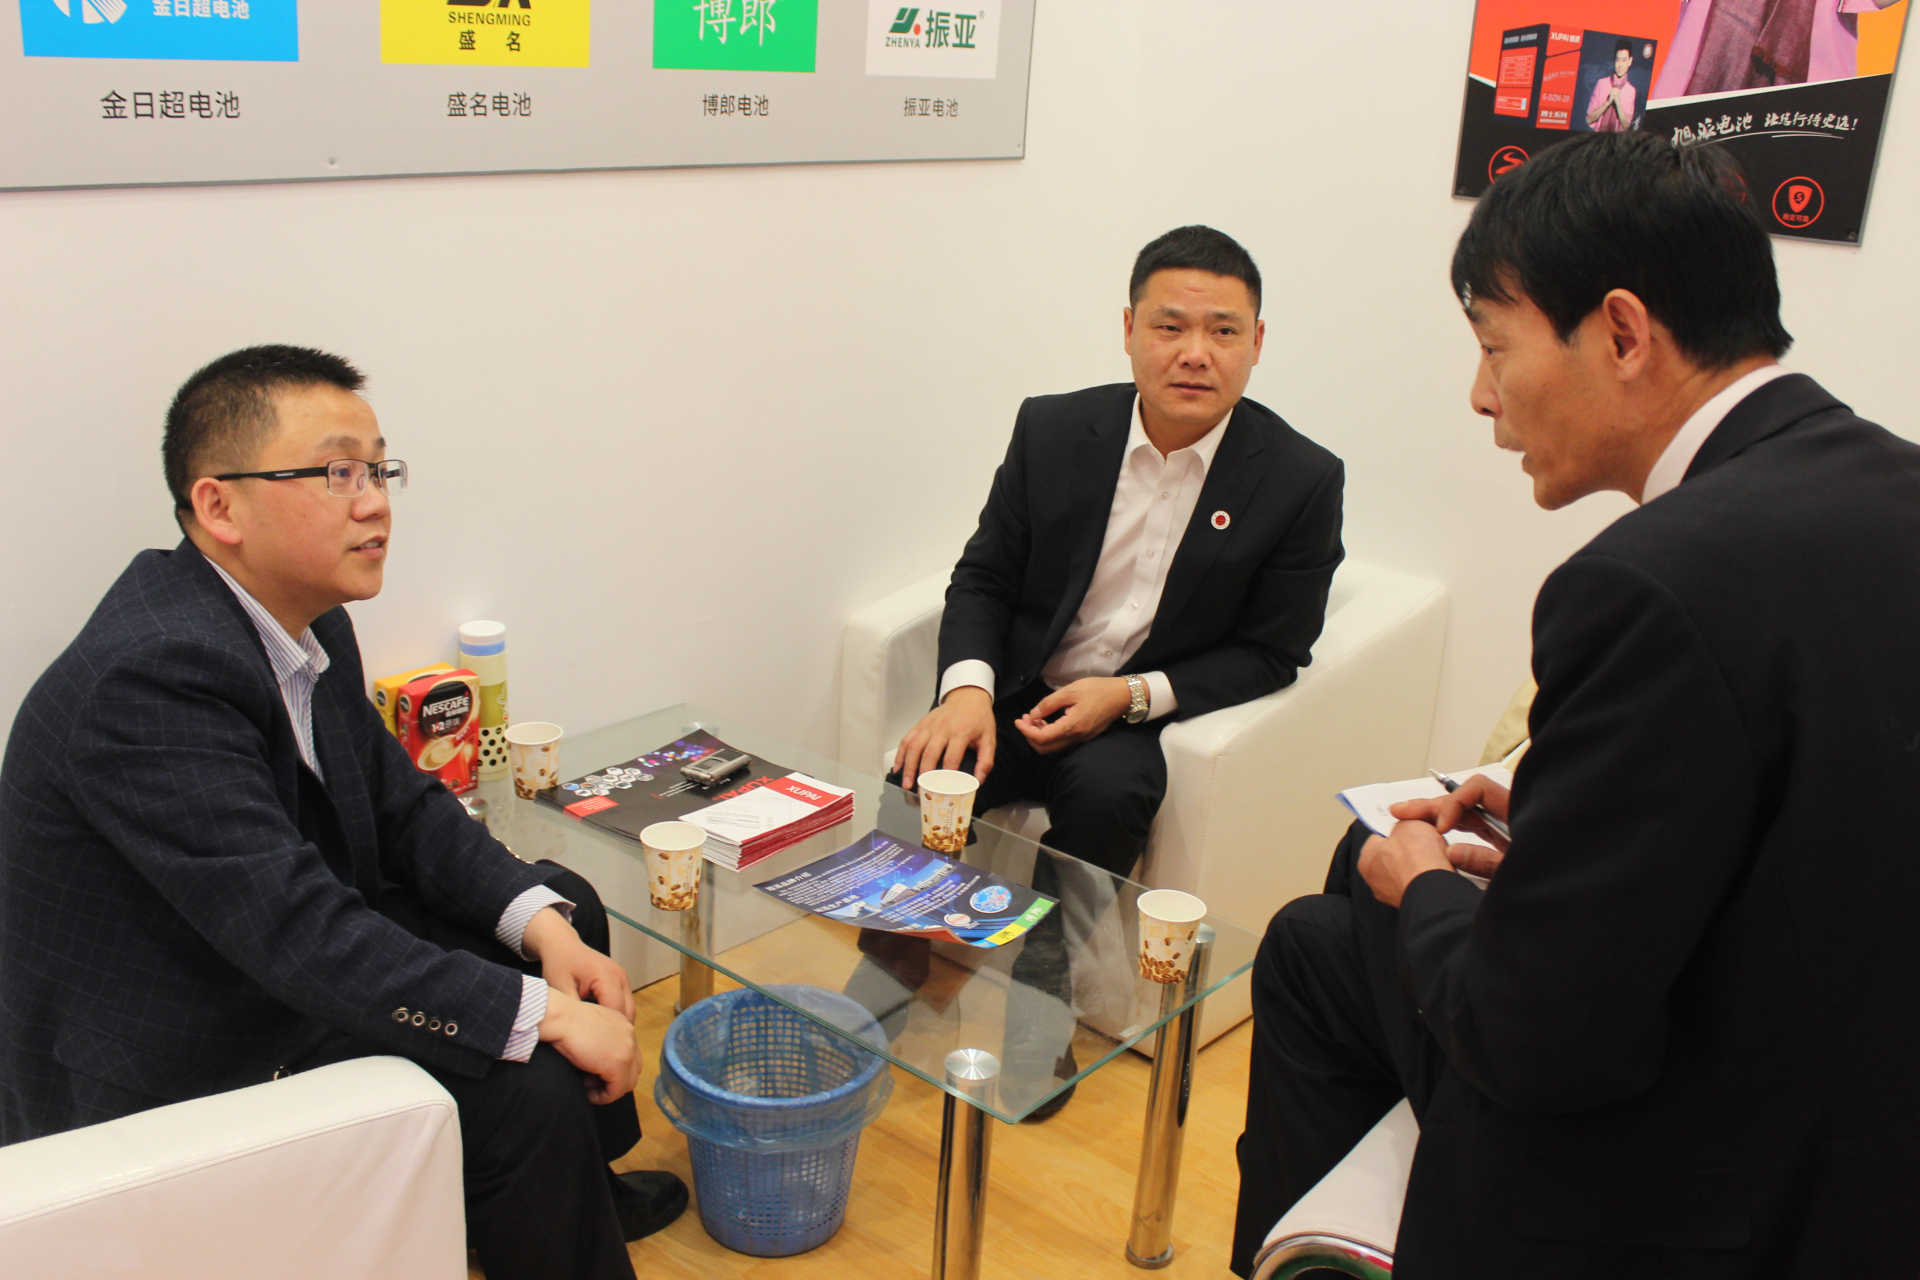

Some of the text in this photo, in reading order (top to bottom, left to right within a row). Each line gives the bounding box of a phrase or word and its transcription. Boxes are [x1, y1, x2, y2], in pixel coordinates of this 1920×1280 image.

[153, 0, 249, 19] 金日超电池
[448, 11, 531, 26] SHENGMING
[925, 9, 976, 48] 振亚
[885, 36, 920, 48] ZHENYA
[101, 90, 240, 120] 金日超电池
[447, 92, 532, 117] 盛名电池
[702, 94, 768, 116] 博郎电池
[904, 97, 959, 117] 振亚电池
